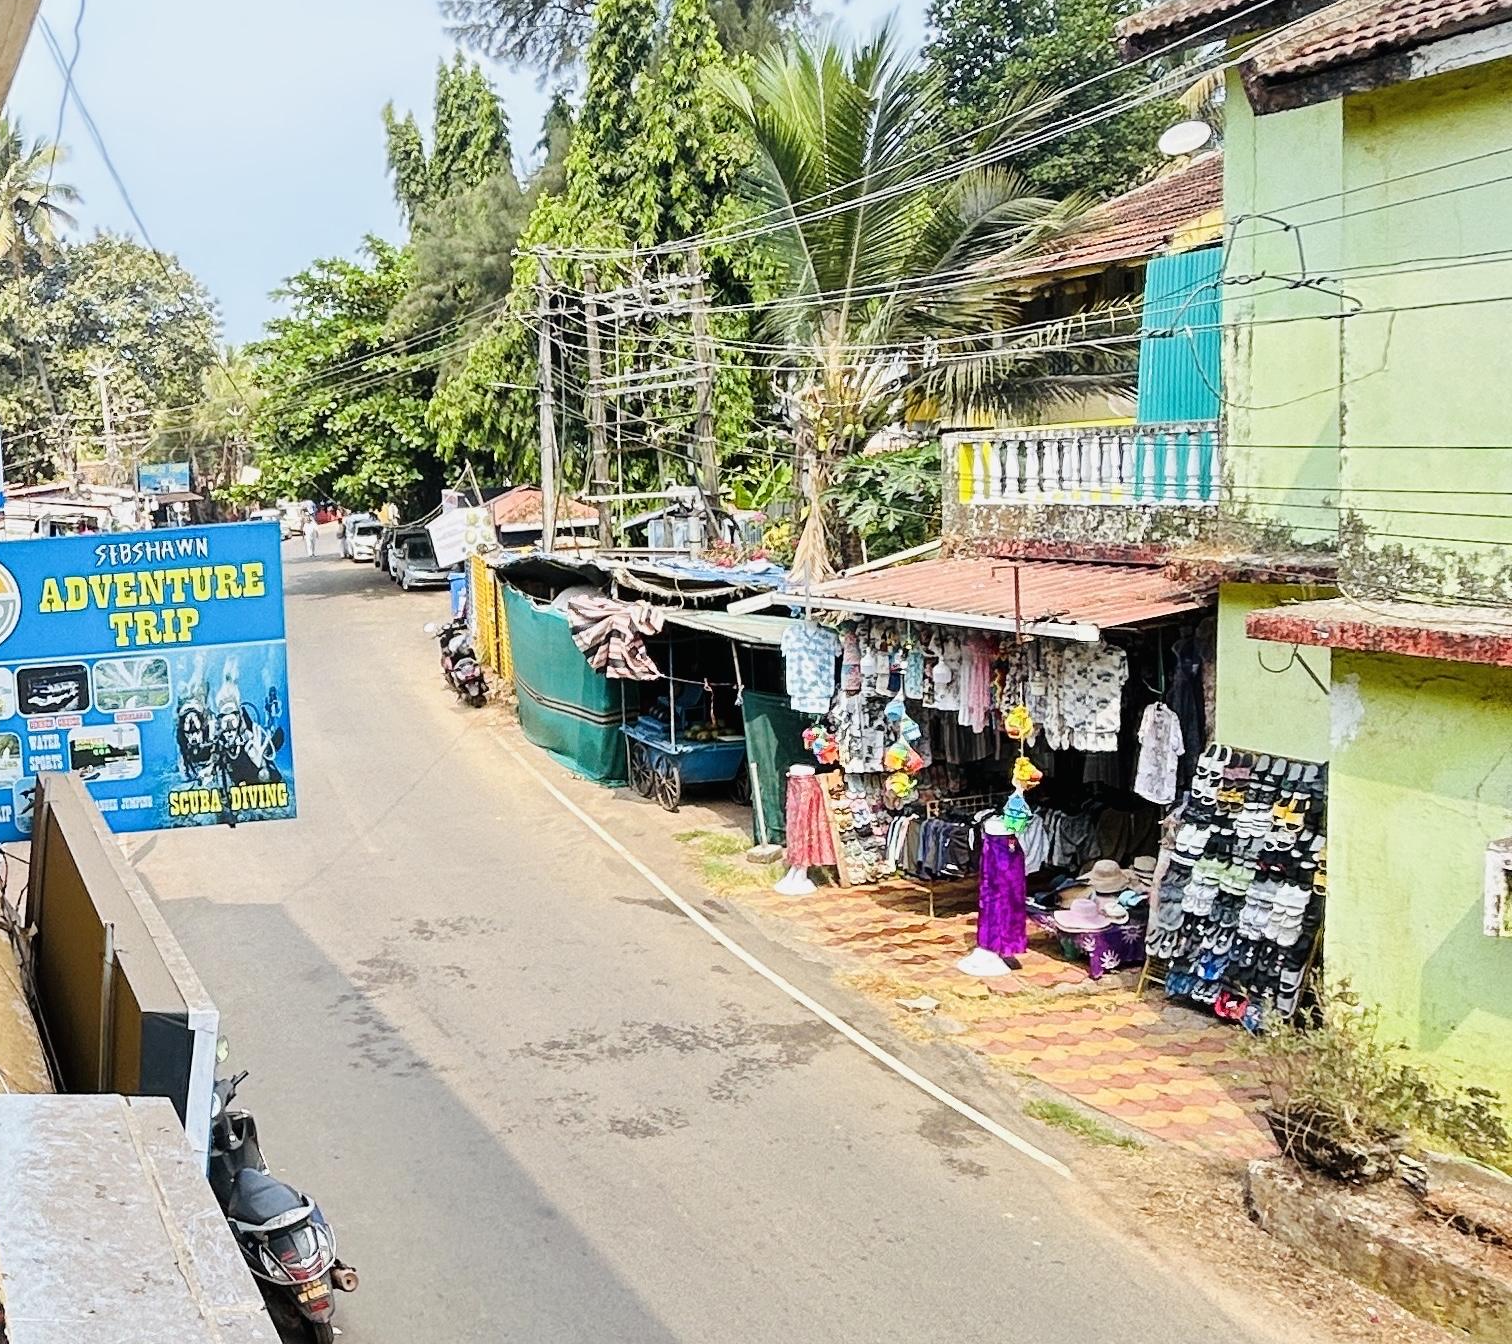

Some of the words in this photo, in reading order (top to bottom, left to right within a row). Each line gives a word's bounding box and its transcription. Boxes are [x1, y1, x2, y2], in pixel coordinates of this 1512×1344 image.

[95, 536, 209, 567] SEBSHAWN
[39, 561, 265, 613] ADVENTURE
[109, 607, 200, 647] TRIP
[28, 734, 61, 750] WATER
[29, 754, 64, 771] SPORTS
[169, 789, 223, 816] SCUBA
[231, 782, 288, 811] DIVING
